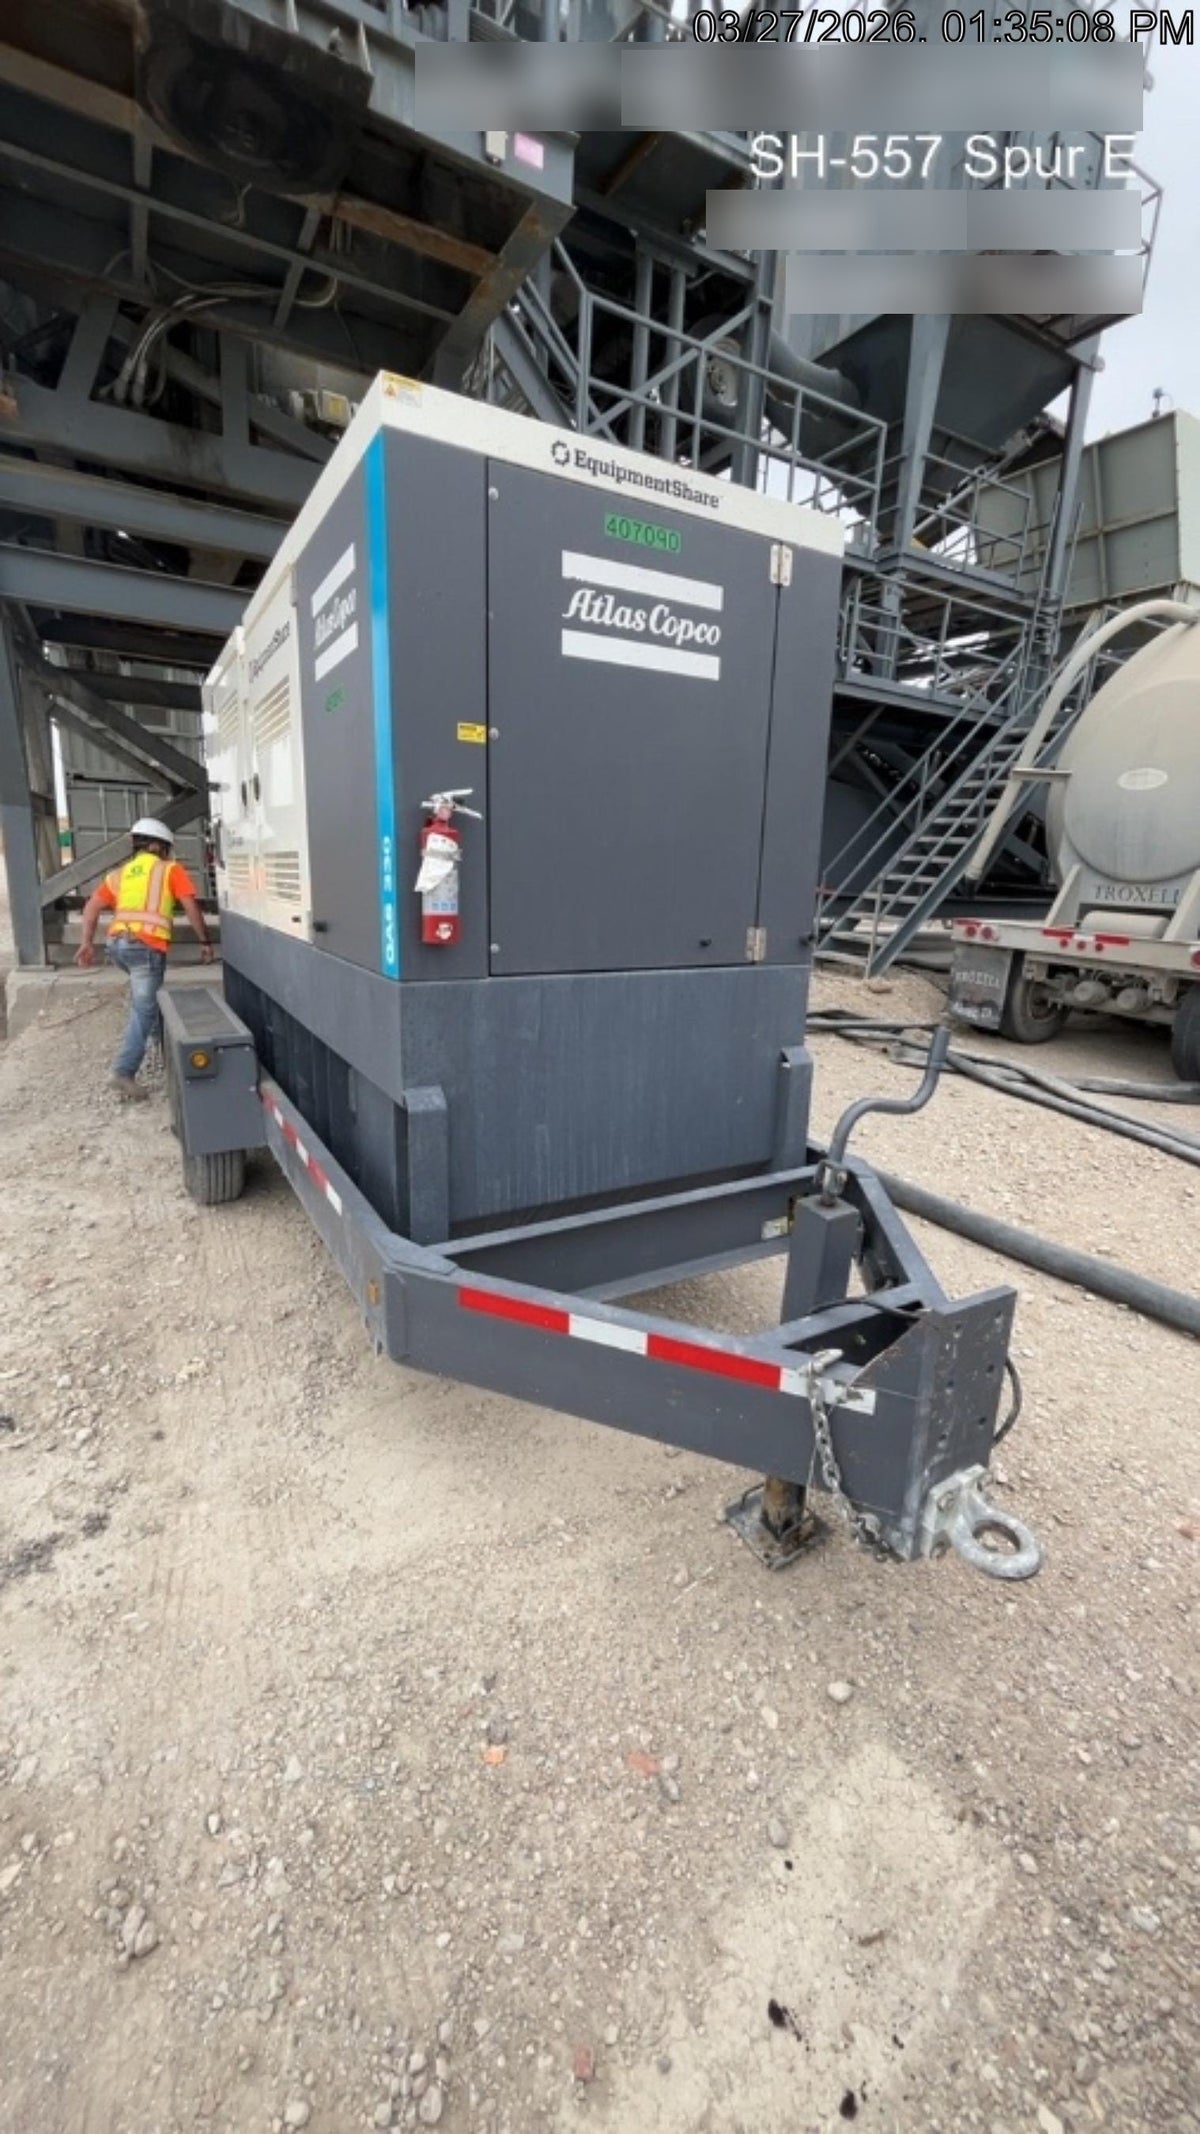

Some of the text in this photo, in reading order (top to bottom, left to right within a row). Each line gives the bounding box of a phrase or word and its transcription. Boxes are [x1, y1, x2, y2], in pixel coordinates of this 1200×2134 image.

[573, 448, 721, 508] EquipmentShare
[606, 516, 680, 552] 407090
[562, 587, 721, 646] Atlas Copco
